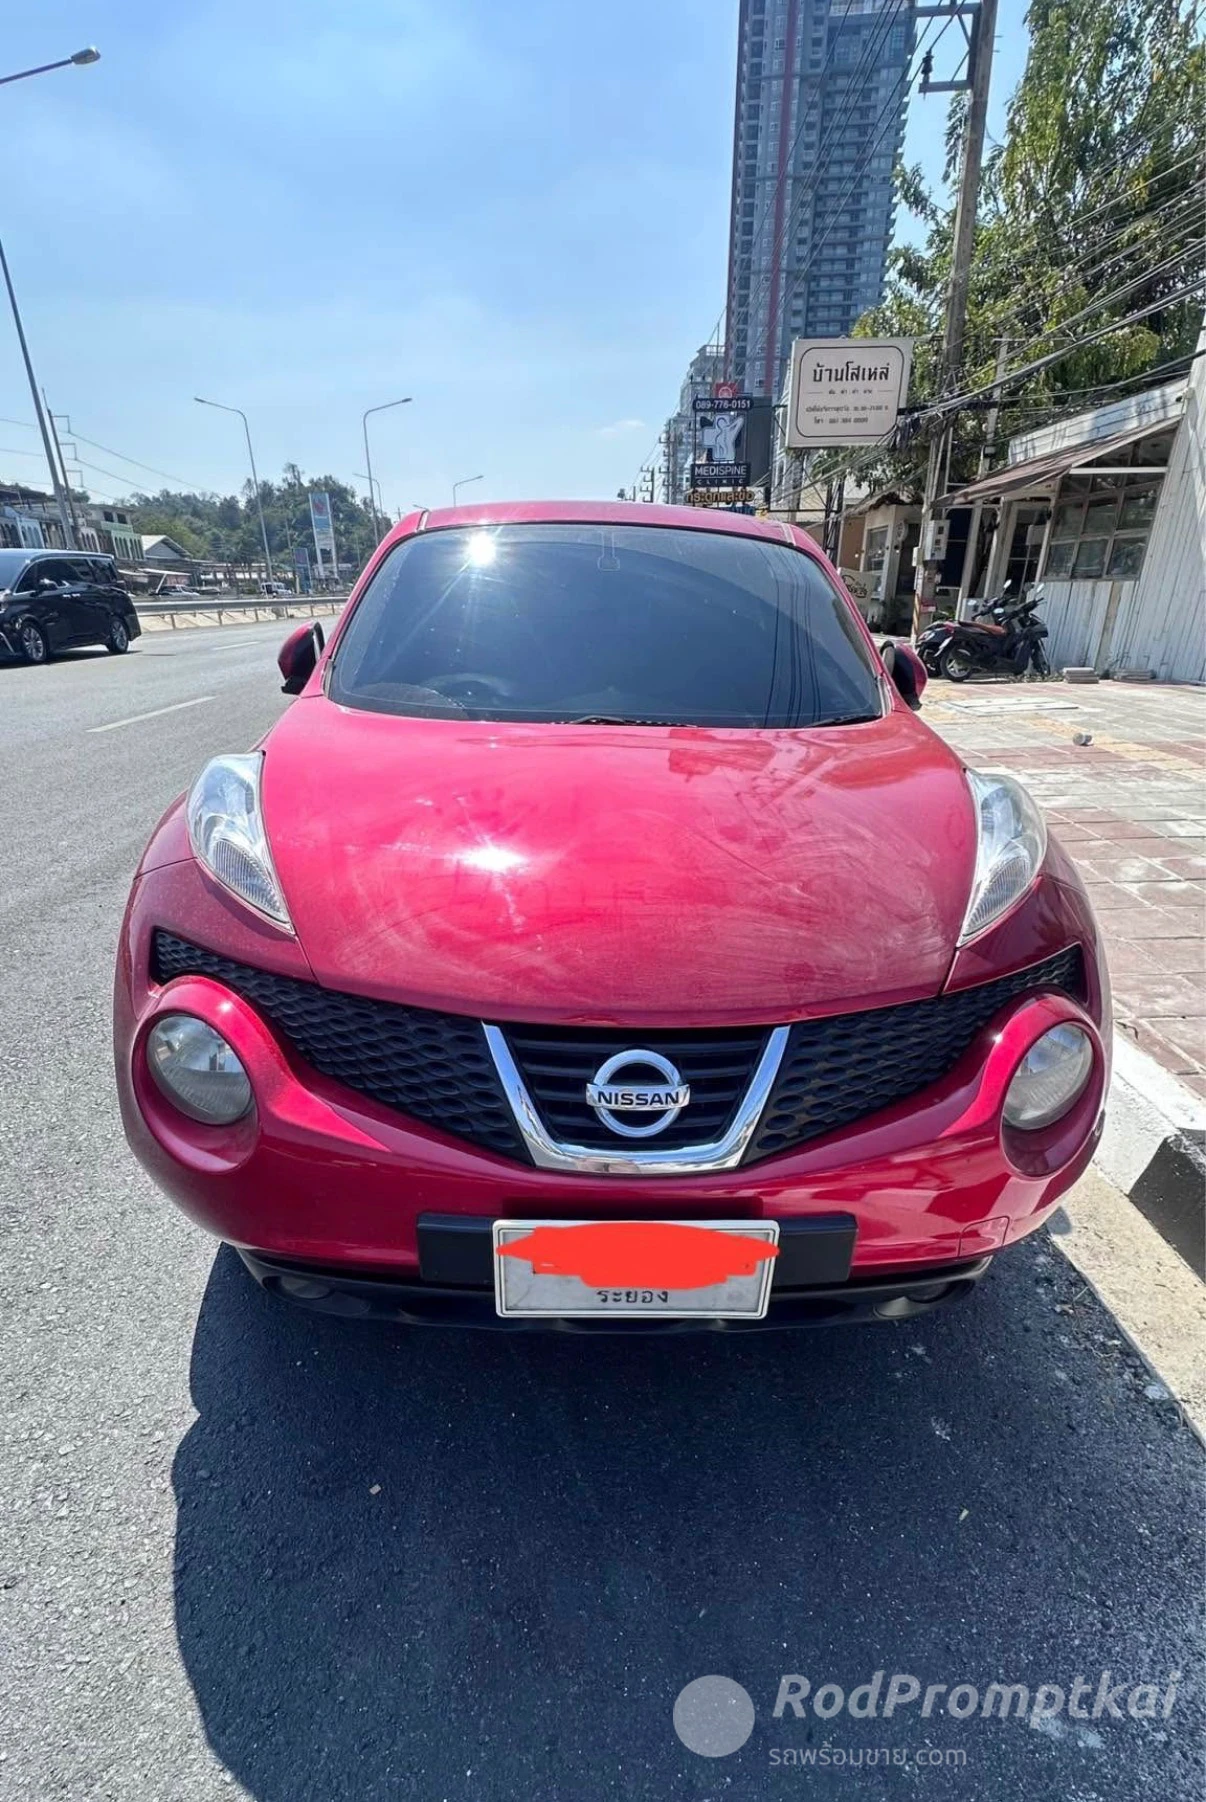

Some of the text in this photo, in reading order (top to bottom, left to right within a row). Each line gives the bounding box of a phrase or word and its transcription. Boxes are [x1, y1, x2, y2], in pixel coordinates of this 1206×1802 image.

[694, 465, 747, 476] MEDISPINE
[597, 1091, 679, 1106] NISSAN
[597, 1290, 669, 1303] ระยอง
